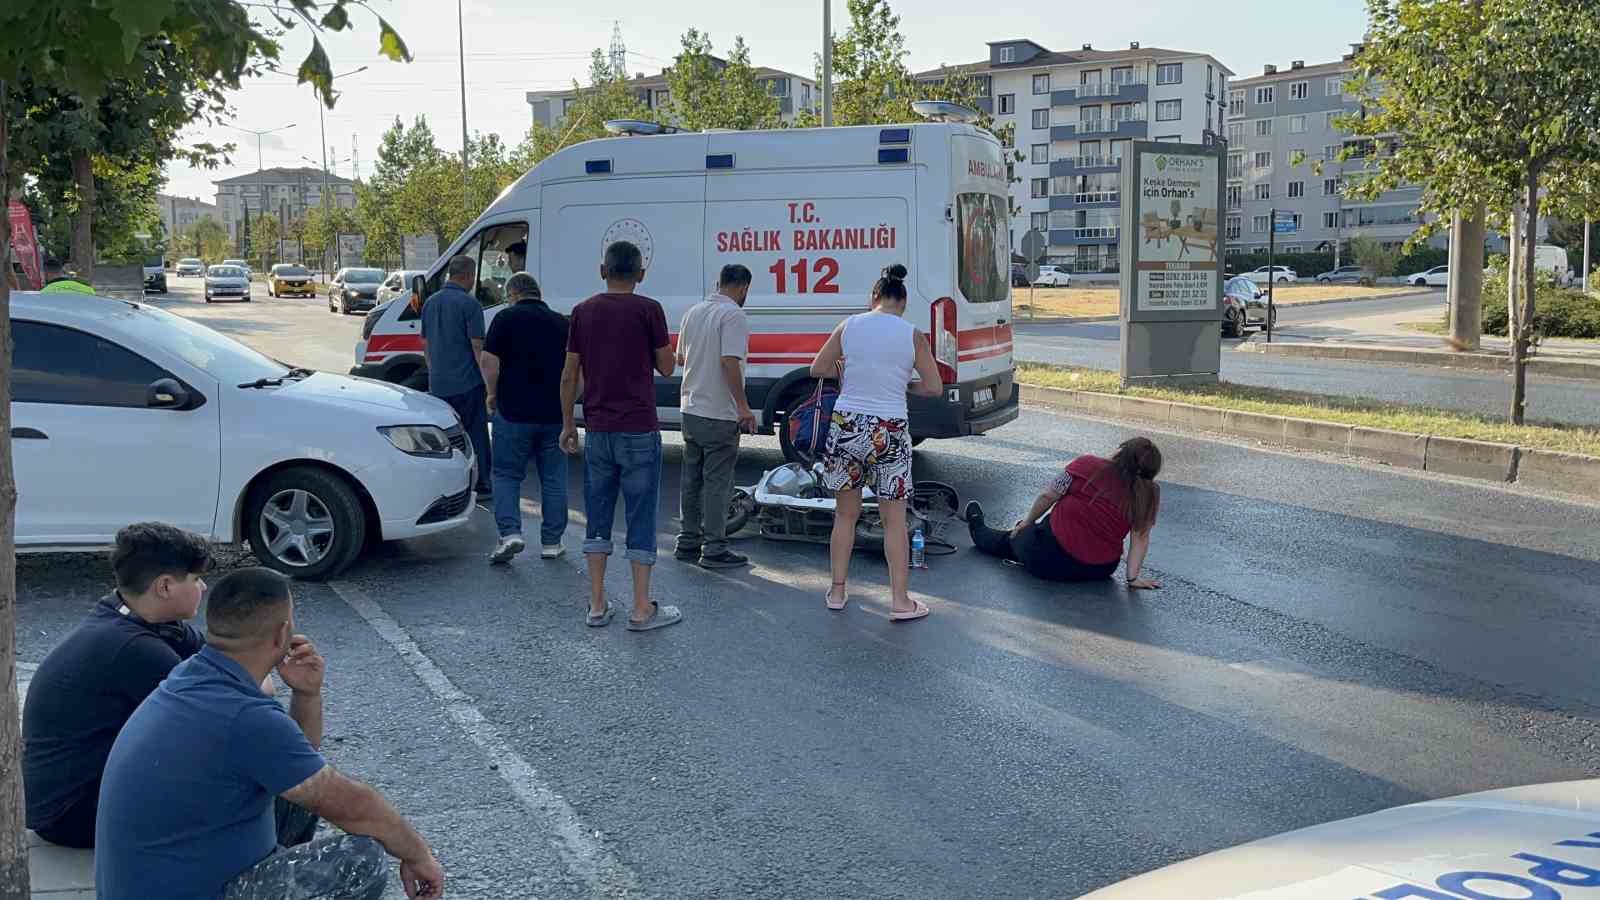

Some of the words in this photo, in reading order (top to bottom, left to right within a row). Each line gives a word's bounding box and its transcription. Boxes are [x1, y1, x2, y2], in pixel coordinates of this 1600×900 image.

[1161, 187, 1195, 198] Orhan's
[787, 202, 821, 224] T.C.
[716, 227, 781, 252] SAĞLIK
[793, 223, 897, 251] BAKANLIĞI
[768, 256, 840, 294] 112
